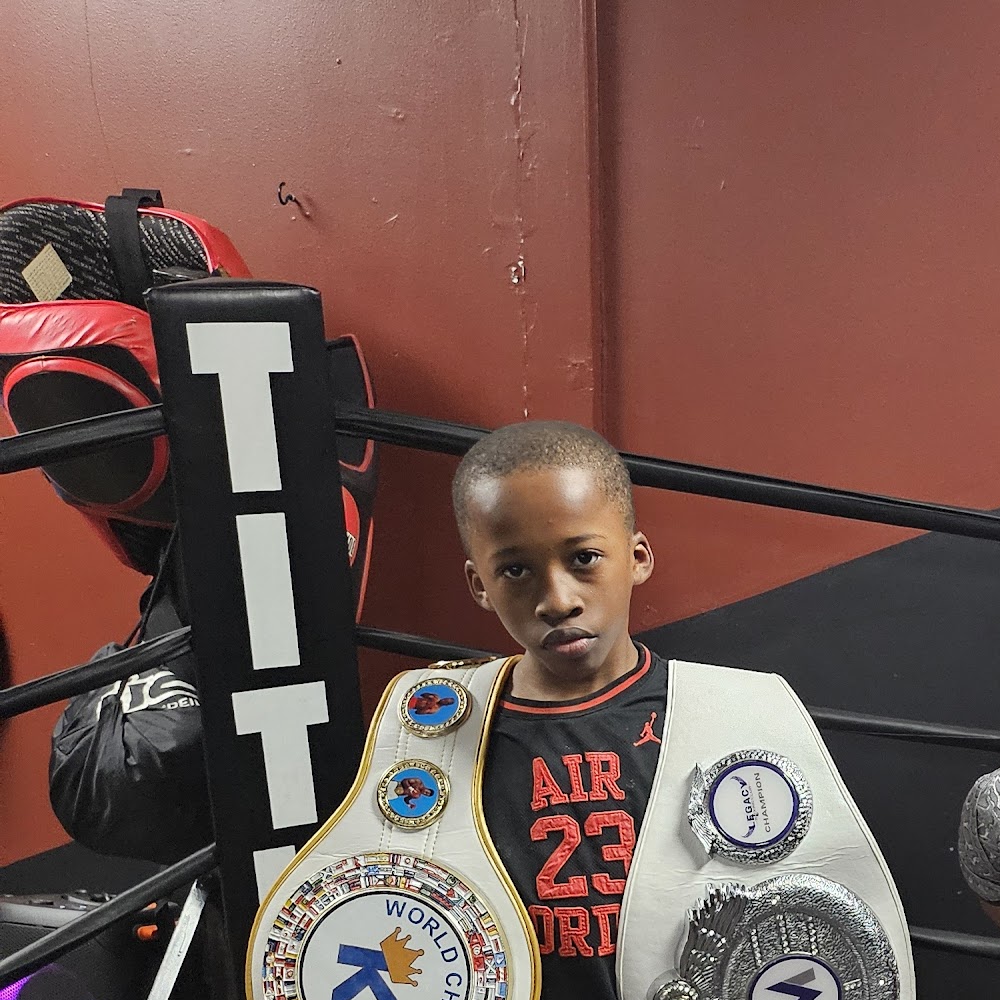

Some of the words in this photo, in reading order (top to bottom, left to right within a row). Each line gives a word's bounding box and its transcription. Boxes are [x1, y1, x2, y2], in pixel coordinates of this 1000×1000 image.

[530, 752, 625, 812] AIR
[738, 778, 756, 831] LEGACY
[754, 772, 771, 833] CHAMPION
[530, 810, 636, 900] 23
[386, 899, 459, 963] WORLD
